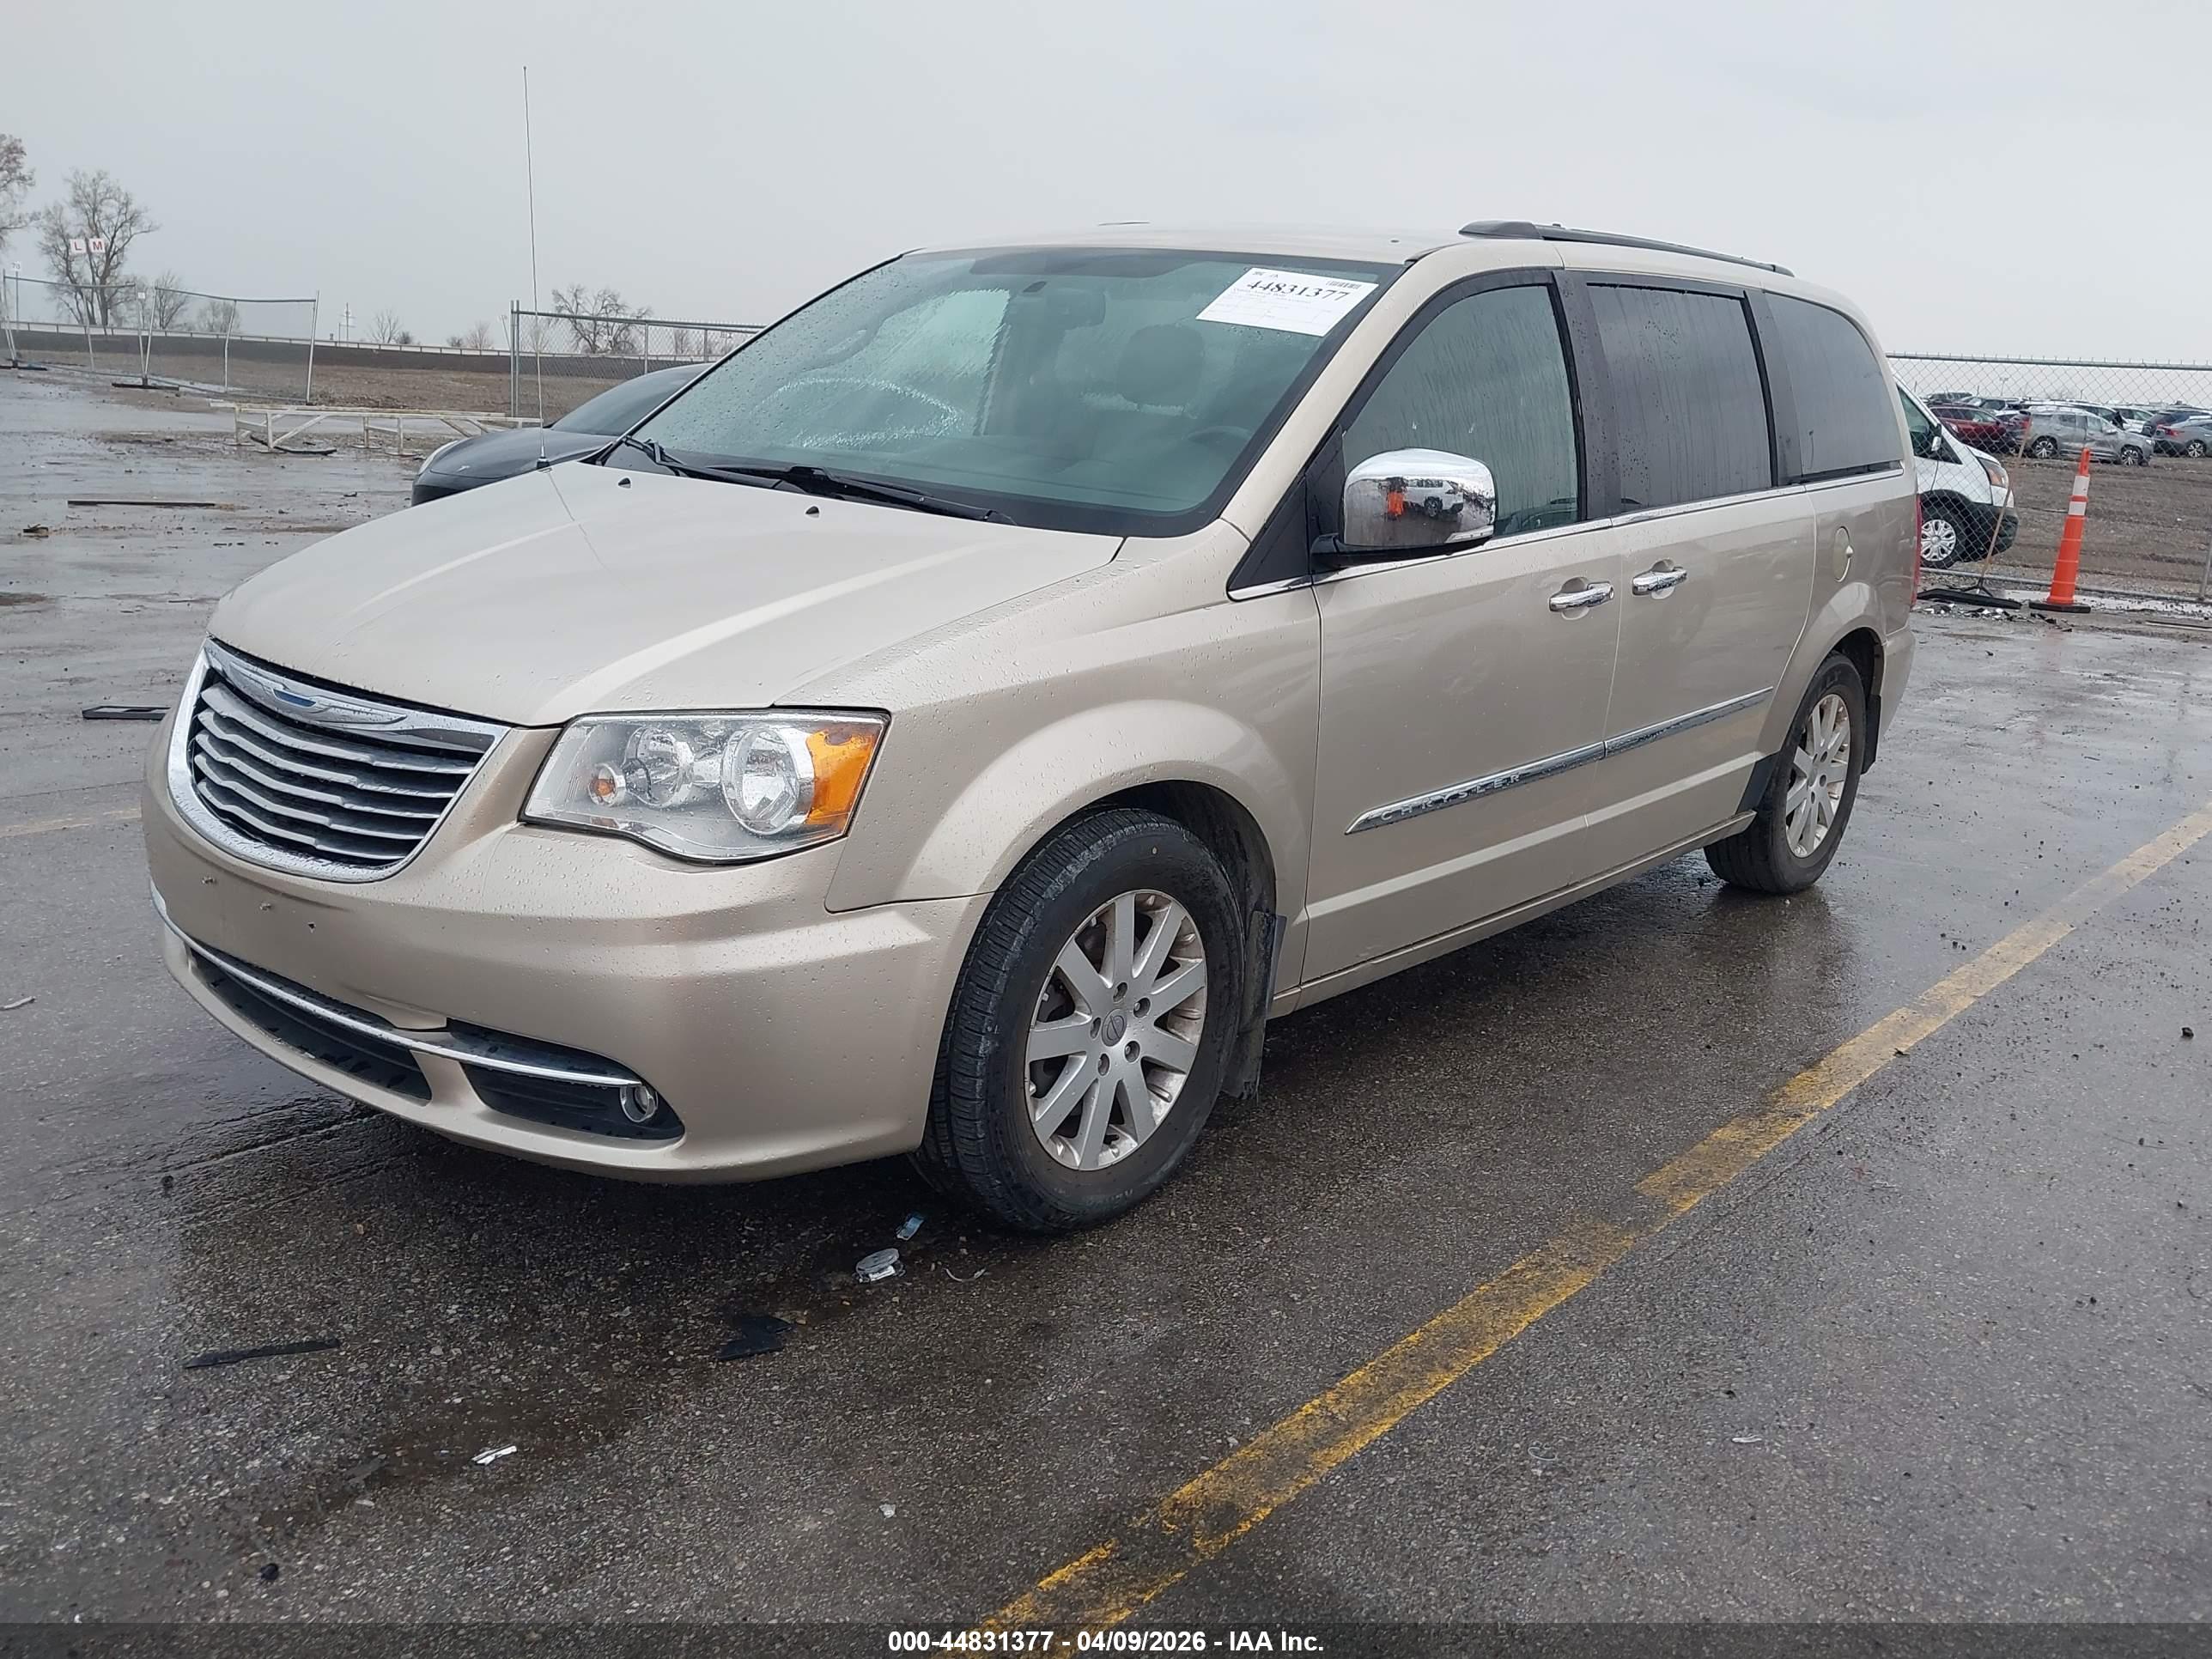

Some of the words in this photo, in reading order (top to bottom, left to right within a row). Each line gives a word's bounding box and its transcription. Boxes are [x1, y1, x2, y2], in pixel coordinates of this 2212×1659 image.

[74, 241, 82, 251] L
[92, 240, 103, 251] M
[1246, 280, 1351, 301] 44831377
[1379, 774, 1521, 822] CHRYSLER
